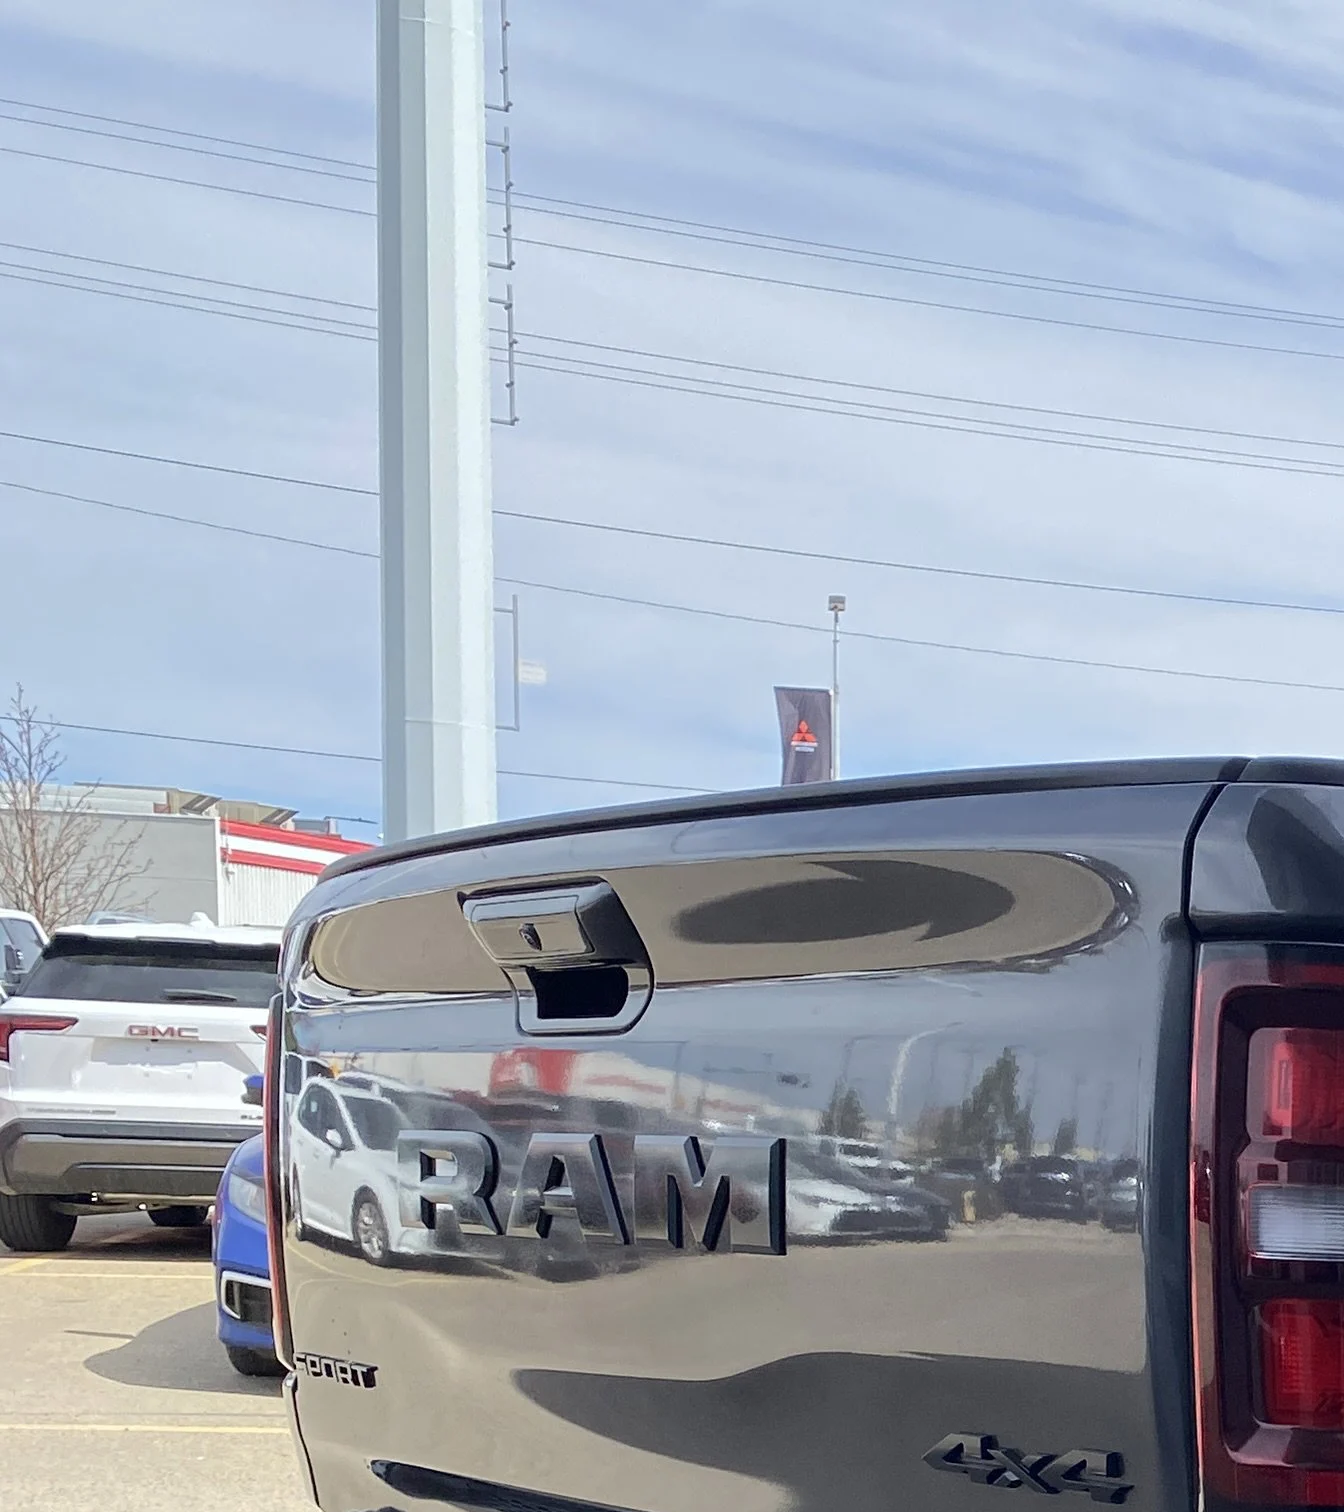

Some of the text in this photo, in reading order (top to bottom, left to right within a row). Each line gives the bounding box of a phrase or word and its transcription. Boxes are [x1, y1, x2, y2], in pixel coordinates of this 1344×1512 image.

[127, 1024, 200, 1038] GMC
[397, 1129, 788, 1256] RAM
[294, 1351, 379, 1389] SPORT
